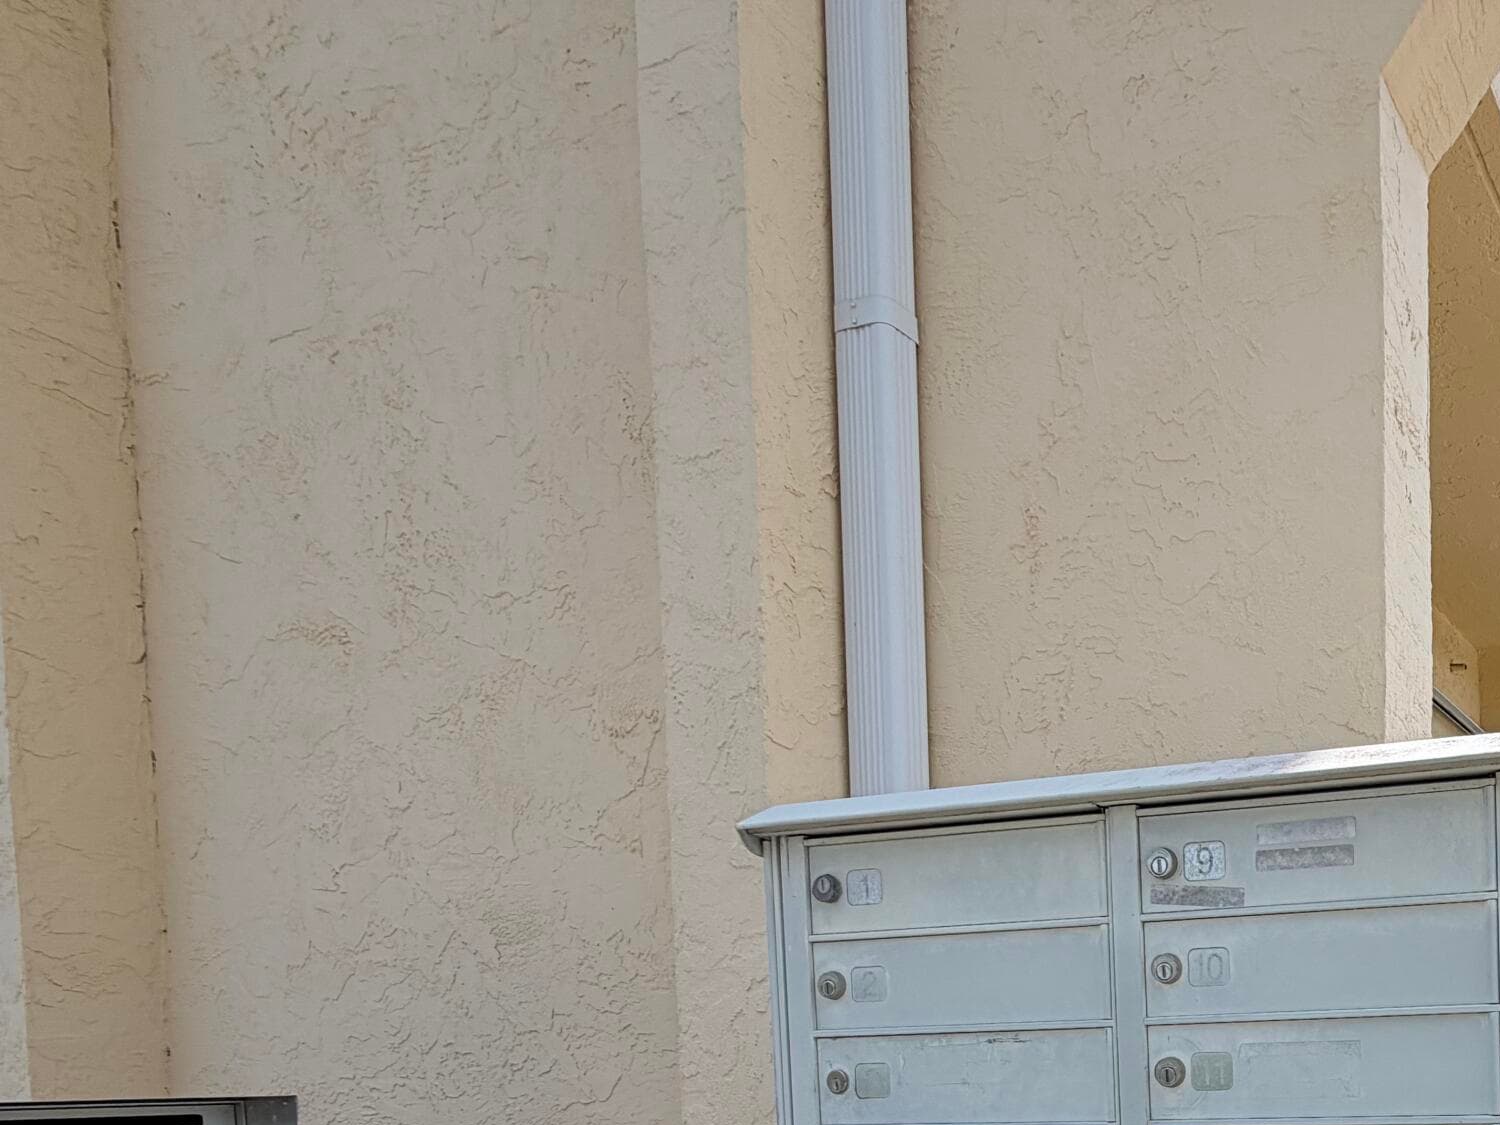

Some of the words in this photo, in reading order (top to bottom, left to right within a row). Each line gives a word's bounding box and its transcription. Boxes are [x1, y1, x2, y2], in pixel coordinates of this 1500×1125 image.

[1196, 846, 1214, 875] 9
[859, 874, 870, 899] 1
[1193, 952, 1223, 981] 10
[862, 971, 878, 998] 2
